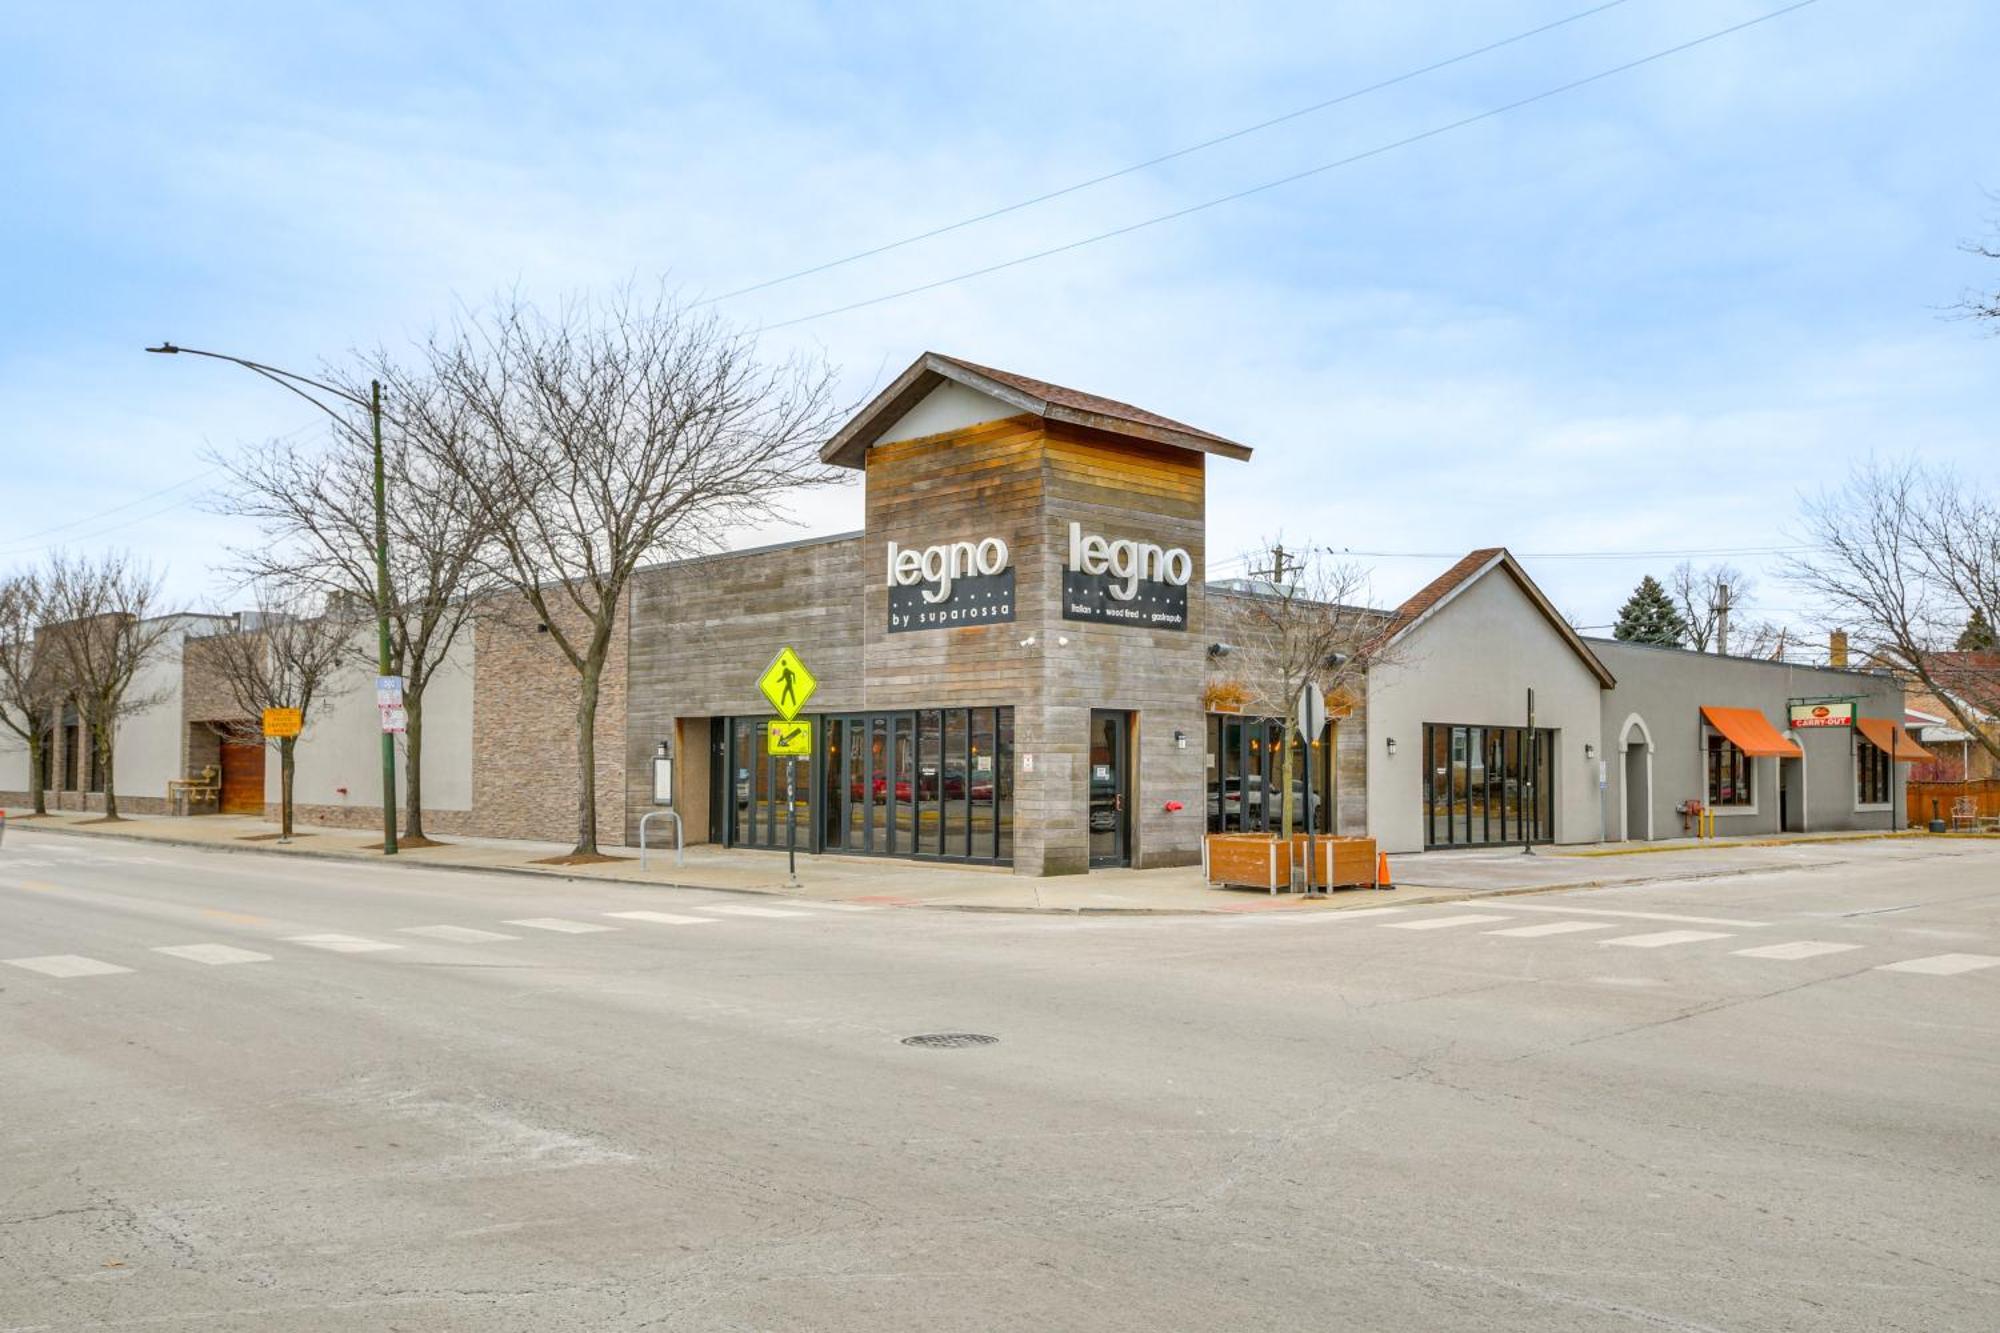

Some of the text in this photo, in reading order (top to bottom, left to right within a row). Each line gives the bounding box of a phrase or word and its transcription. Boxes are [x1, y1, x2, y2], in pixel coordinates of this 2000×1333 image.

[887, 537, 1009, 604] legno
[1068, 522, 1192, 601] legno
[892, 605, 1009, 628] by suparossa
[1106, 608, 1124, 617] wood
[1796, 718, 1845, 727] CARRY-OUT
